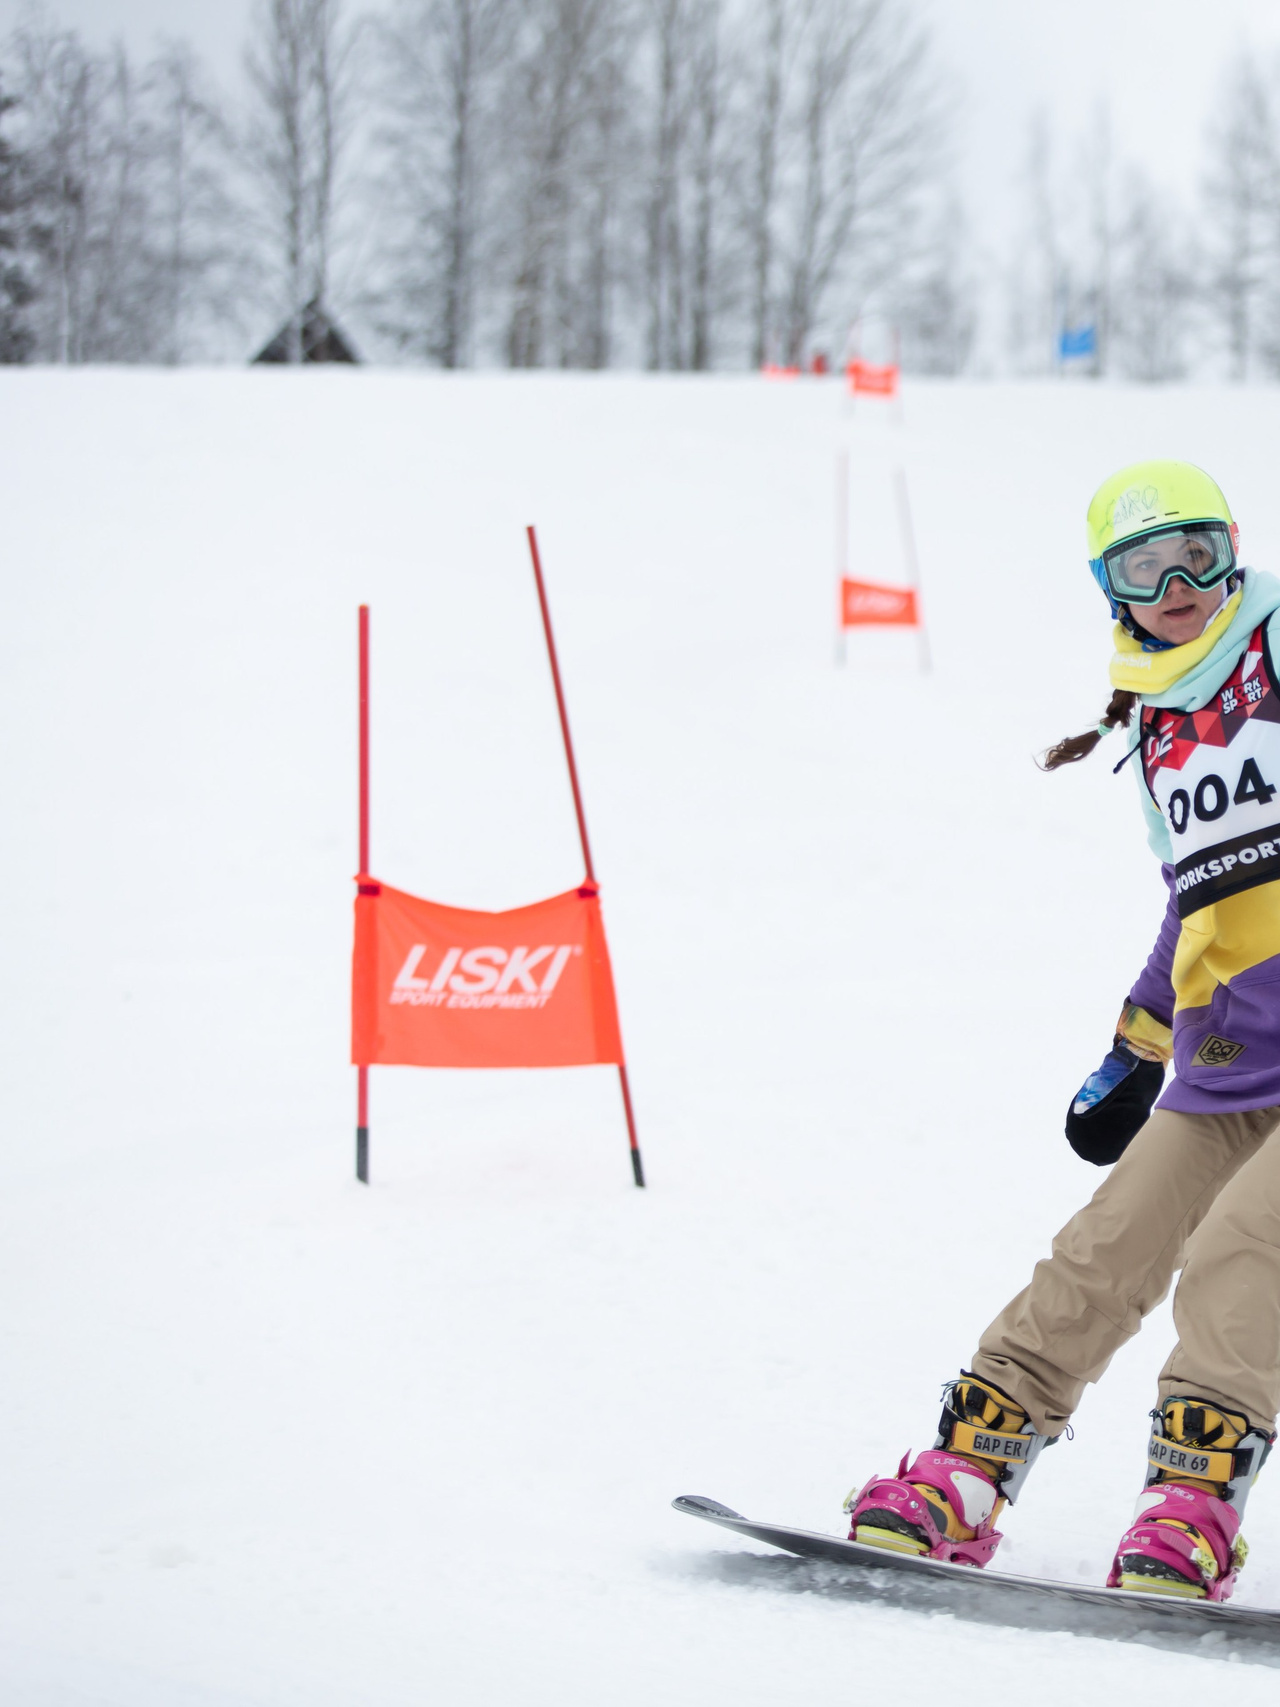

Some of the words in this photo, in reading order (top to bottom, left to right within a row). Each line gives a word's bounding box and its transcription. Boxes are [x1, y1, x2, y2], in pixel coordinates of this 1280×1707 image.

[1168, 757, 1277, 835] 004
[393, 944, 573, 993] LISKI
[389, 990, 447, 1006] SPORT
[446, 992, 553, 1009] EQUIPMENT
[973, 1434, 1001, 1453] GAP
[1003, 1440, 1022, 1457] ER
[1169, 1449, 1187, 1468] ER
[1190, 1456, 1209, 1472] 69
